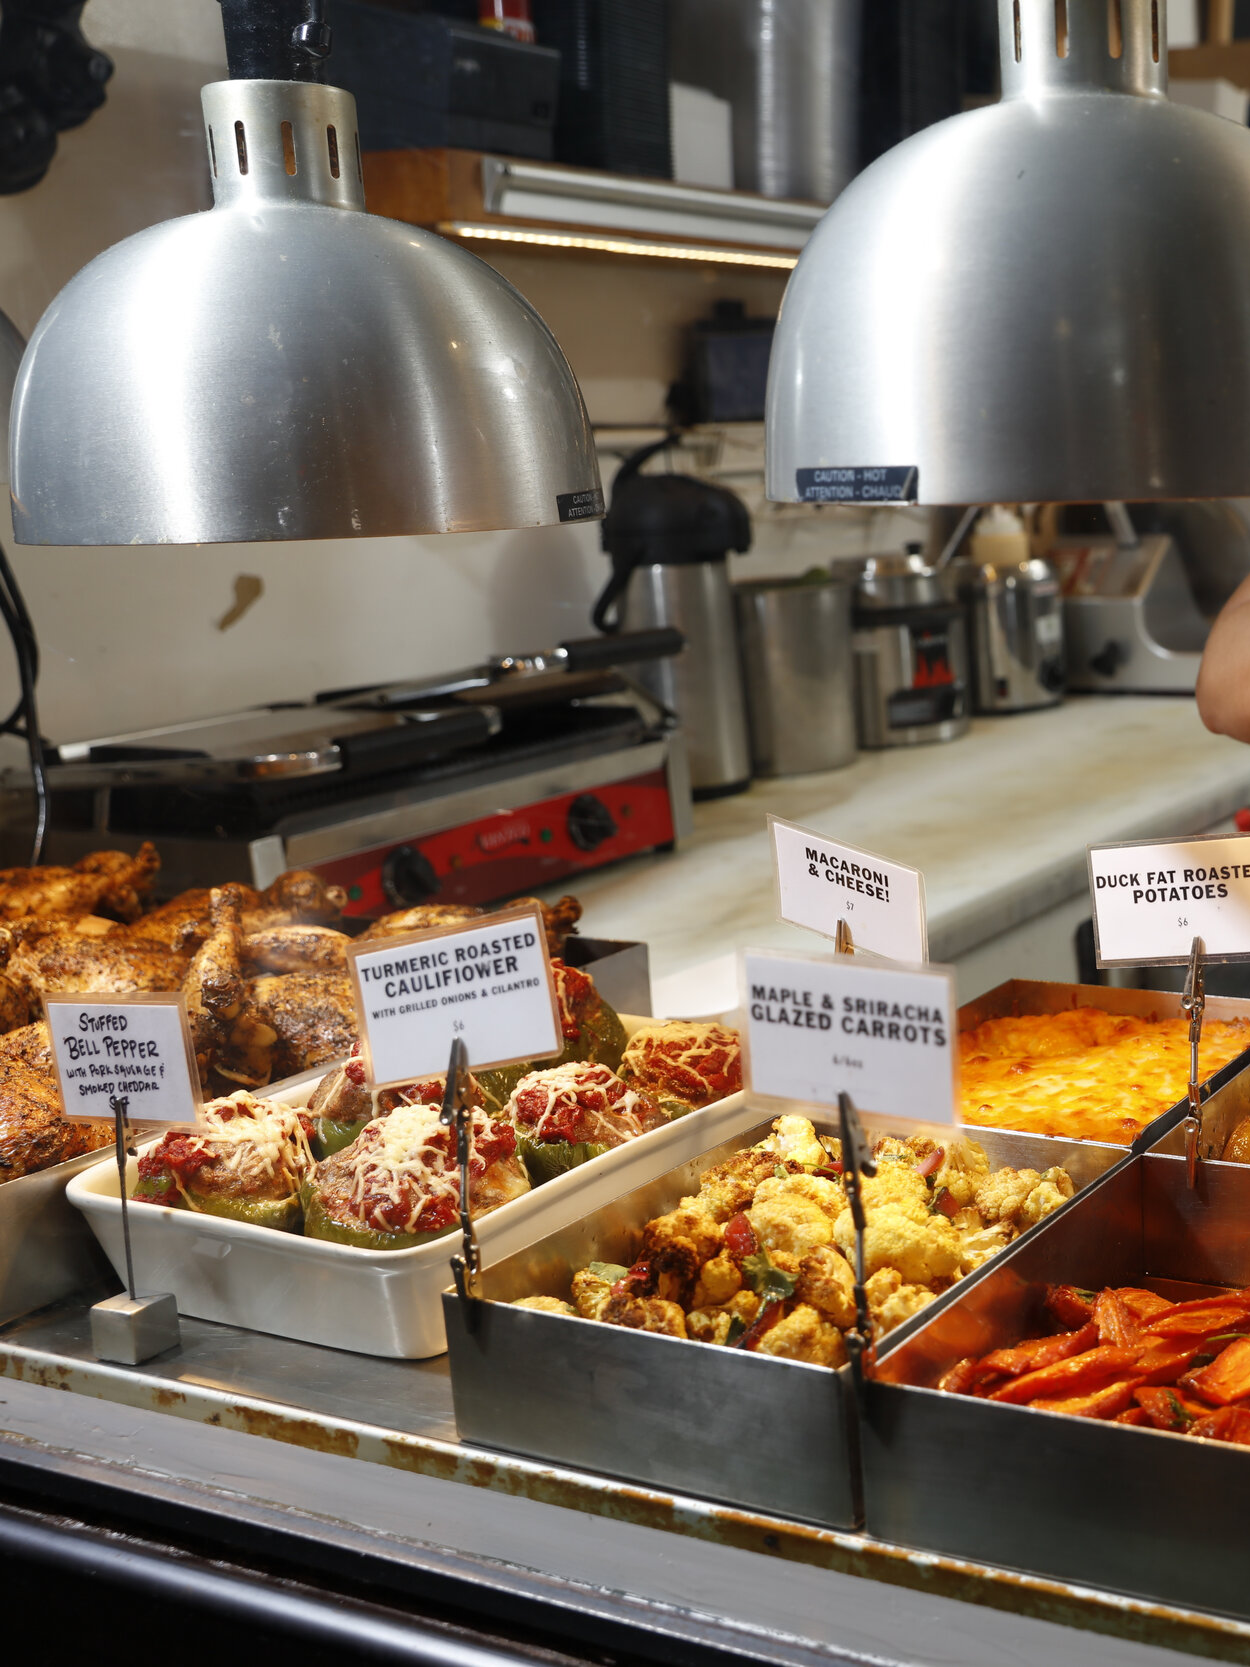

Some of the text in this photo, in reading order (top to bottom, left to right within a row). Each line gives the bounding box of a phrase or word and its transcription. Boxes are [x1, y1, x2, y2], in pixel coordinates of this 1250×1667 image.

[814, 469, 855, 482] CAUTION
[863, 468, 887, 482] HOT
[805, 485, 854, 498] ATTENTION
[805, 847, 889, 888] MACARONI
[808, 863, 890, 903] & CHEESE!
[1096, 873, 1140, 889] DUCK
[1147, 870, 1176, 885] FAT
[1133, 883, 1228, 904] POTATOES
[1177, 917, 1189, 928] $6
[361, 932, 536, 982] TURMERIC ROASTED
[372, 977, 540, 1020] WITH GRILLED ONIONS & CILANTRO
[752, 984, 944, 1024] MAPLE & SRIRACHA
[79, 1012, 128, 1032] STUFFED
[453, 1020, 464, 1032] $6
[751, 1003, 946, 1047] GLAZED CARROTS
[64, 1036, 159, 1060] BELL PEPPER
[67, 1067, 87, 1079] WITH
[89, 1064, 113, 1078] PORK
[114, 1063, 156, 1078] SAUSAGE
[79, 1080, 160, 1096] SMOKED CHEDDAR
